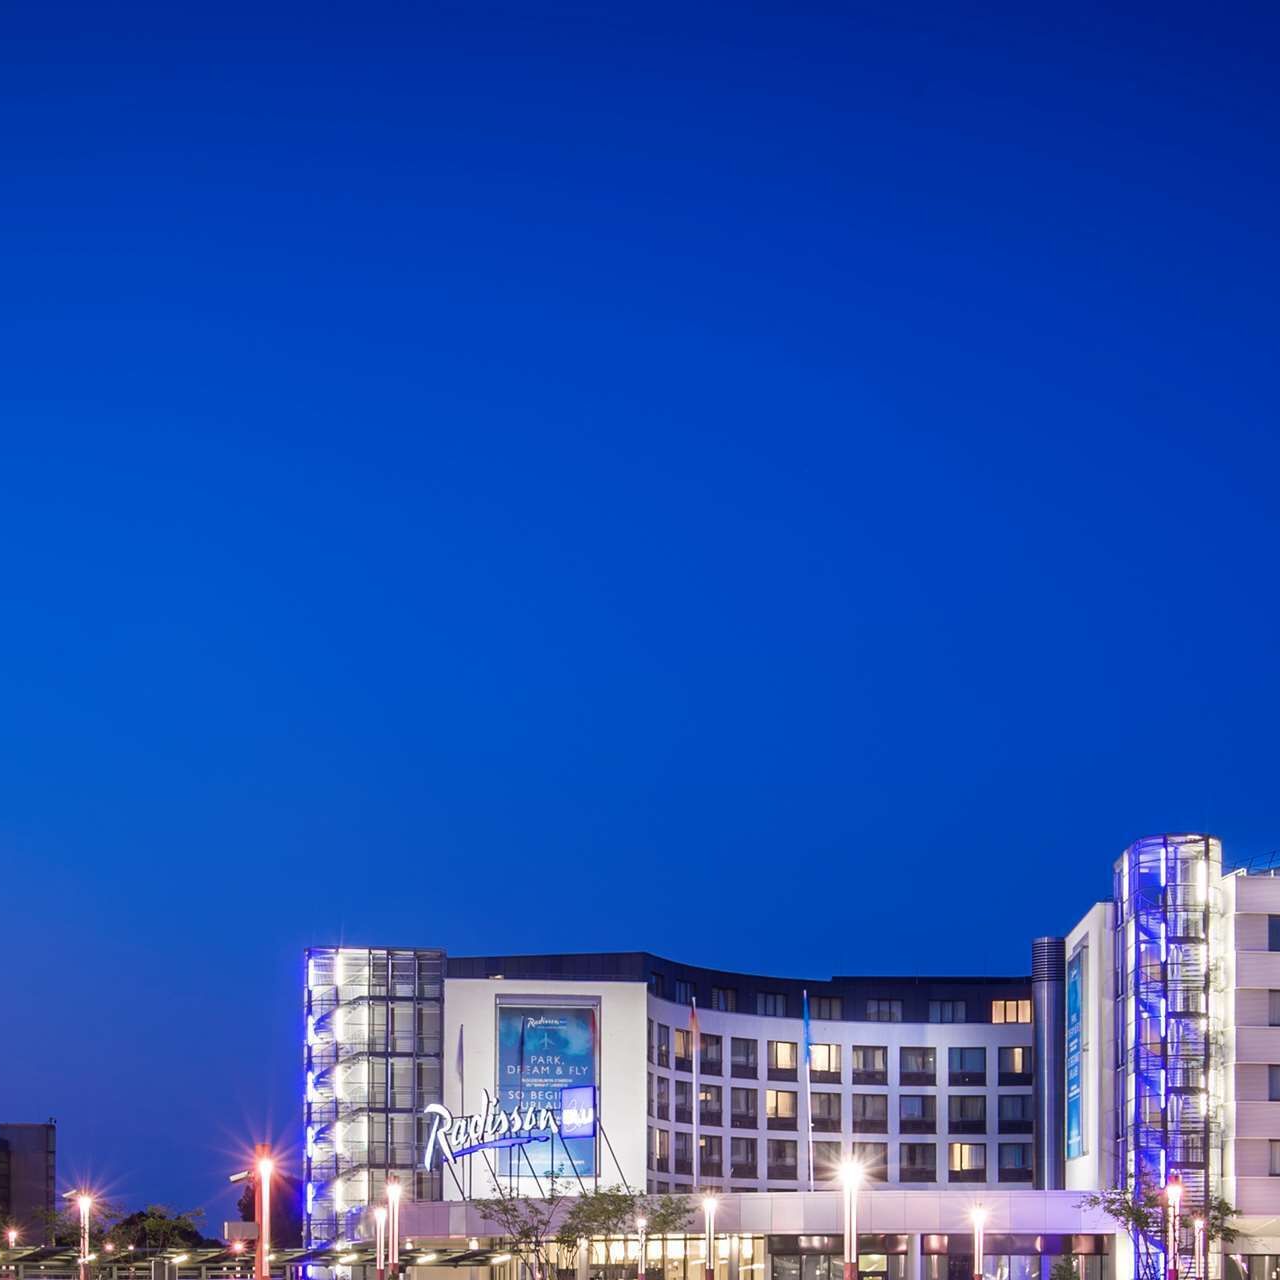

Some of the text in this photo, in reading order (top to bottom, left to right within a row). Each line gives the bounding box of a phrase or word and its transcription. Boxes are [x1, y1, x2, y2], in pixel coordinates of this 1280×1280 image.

[568, 1066, 589, 1076] FLY
[508, 1090, 524, 1100] SO
[424, 1088, 559, 1172] Radisson
